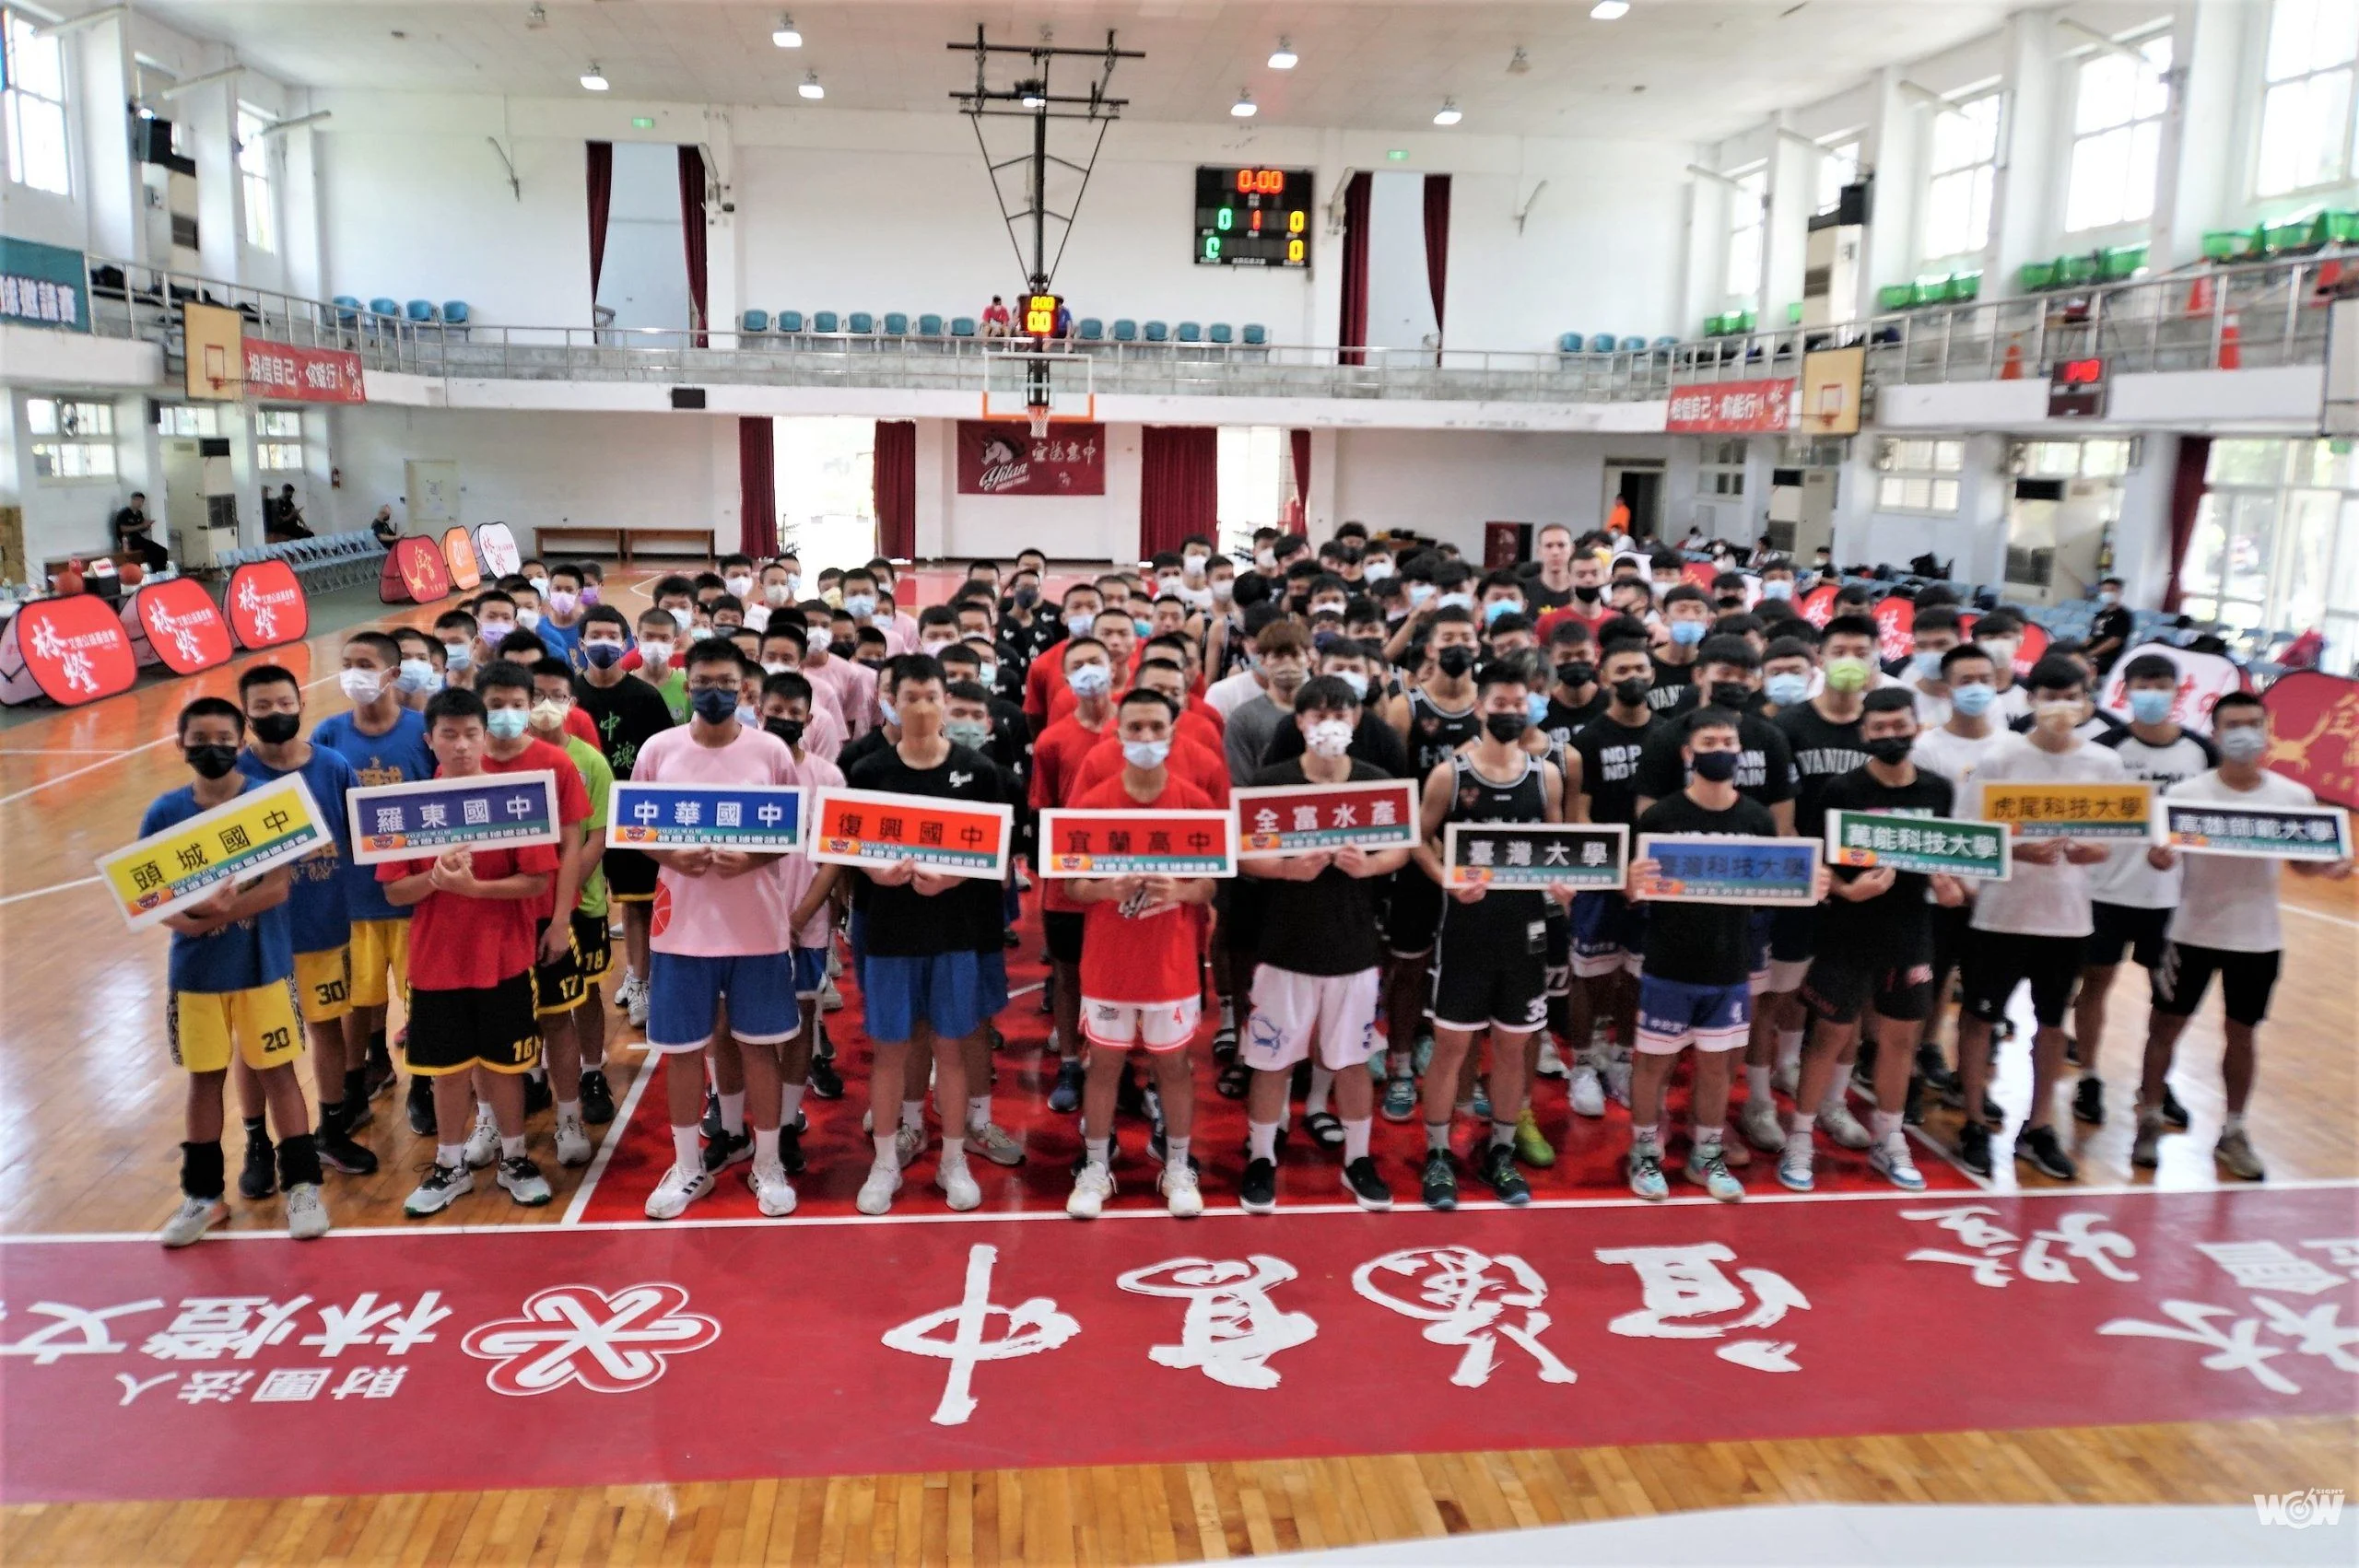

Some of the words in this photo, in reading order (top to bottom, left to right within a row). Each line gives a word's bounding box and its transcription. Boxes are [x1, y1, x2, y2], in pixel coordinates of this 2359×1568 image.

[1217, 208, 1232, 230] 0
[1289, 211, 1305, 233] 0
[1734, 768, 1766, 787] AIN
[376, 795, 532, 834] 羅東國中
[634, 800, 782, 828] 中華國中
[1994, 796, 2142, 819] 虎尾科技大學
[839, 813, 982, 848] 復興國中
[1068, 830, 1212, 854] 宜蘭高中
[1847, 824, 1999, 860] 萬能科技大學
[129, 810, 289, 893] 頭城國中
[1468, 840, 1609, 867] 臺灣大學
[315, 980, 346, 1006] 30
[559, 975, 579, 1000] 17
[261, 1026, 290, 1053] 20
[0, 1292, 452, 1366] 林燈文
[114, 1365, 407, 1407] 財團法人
